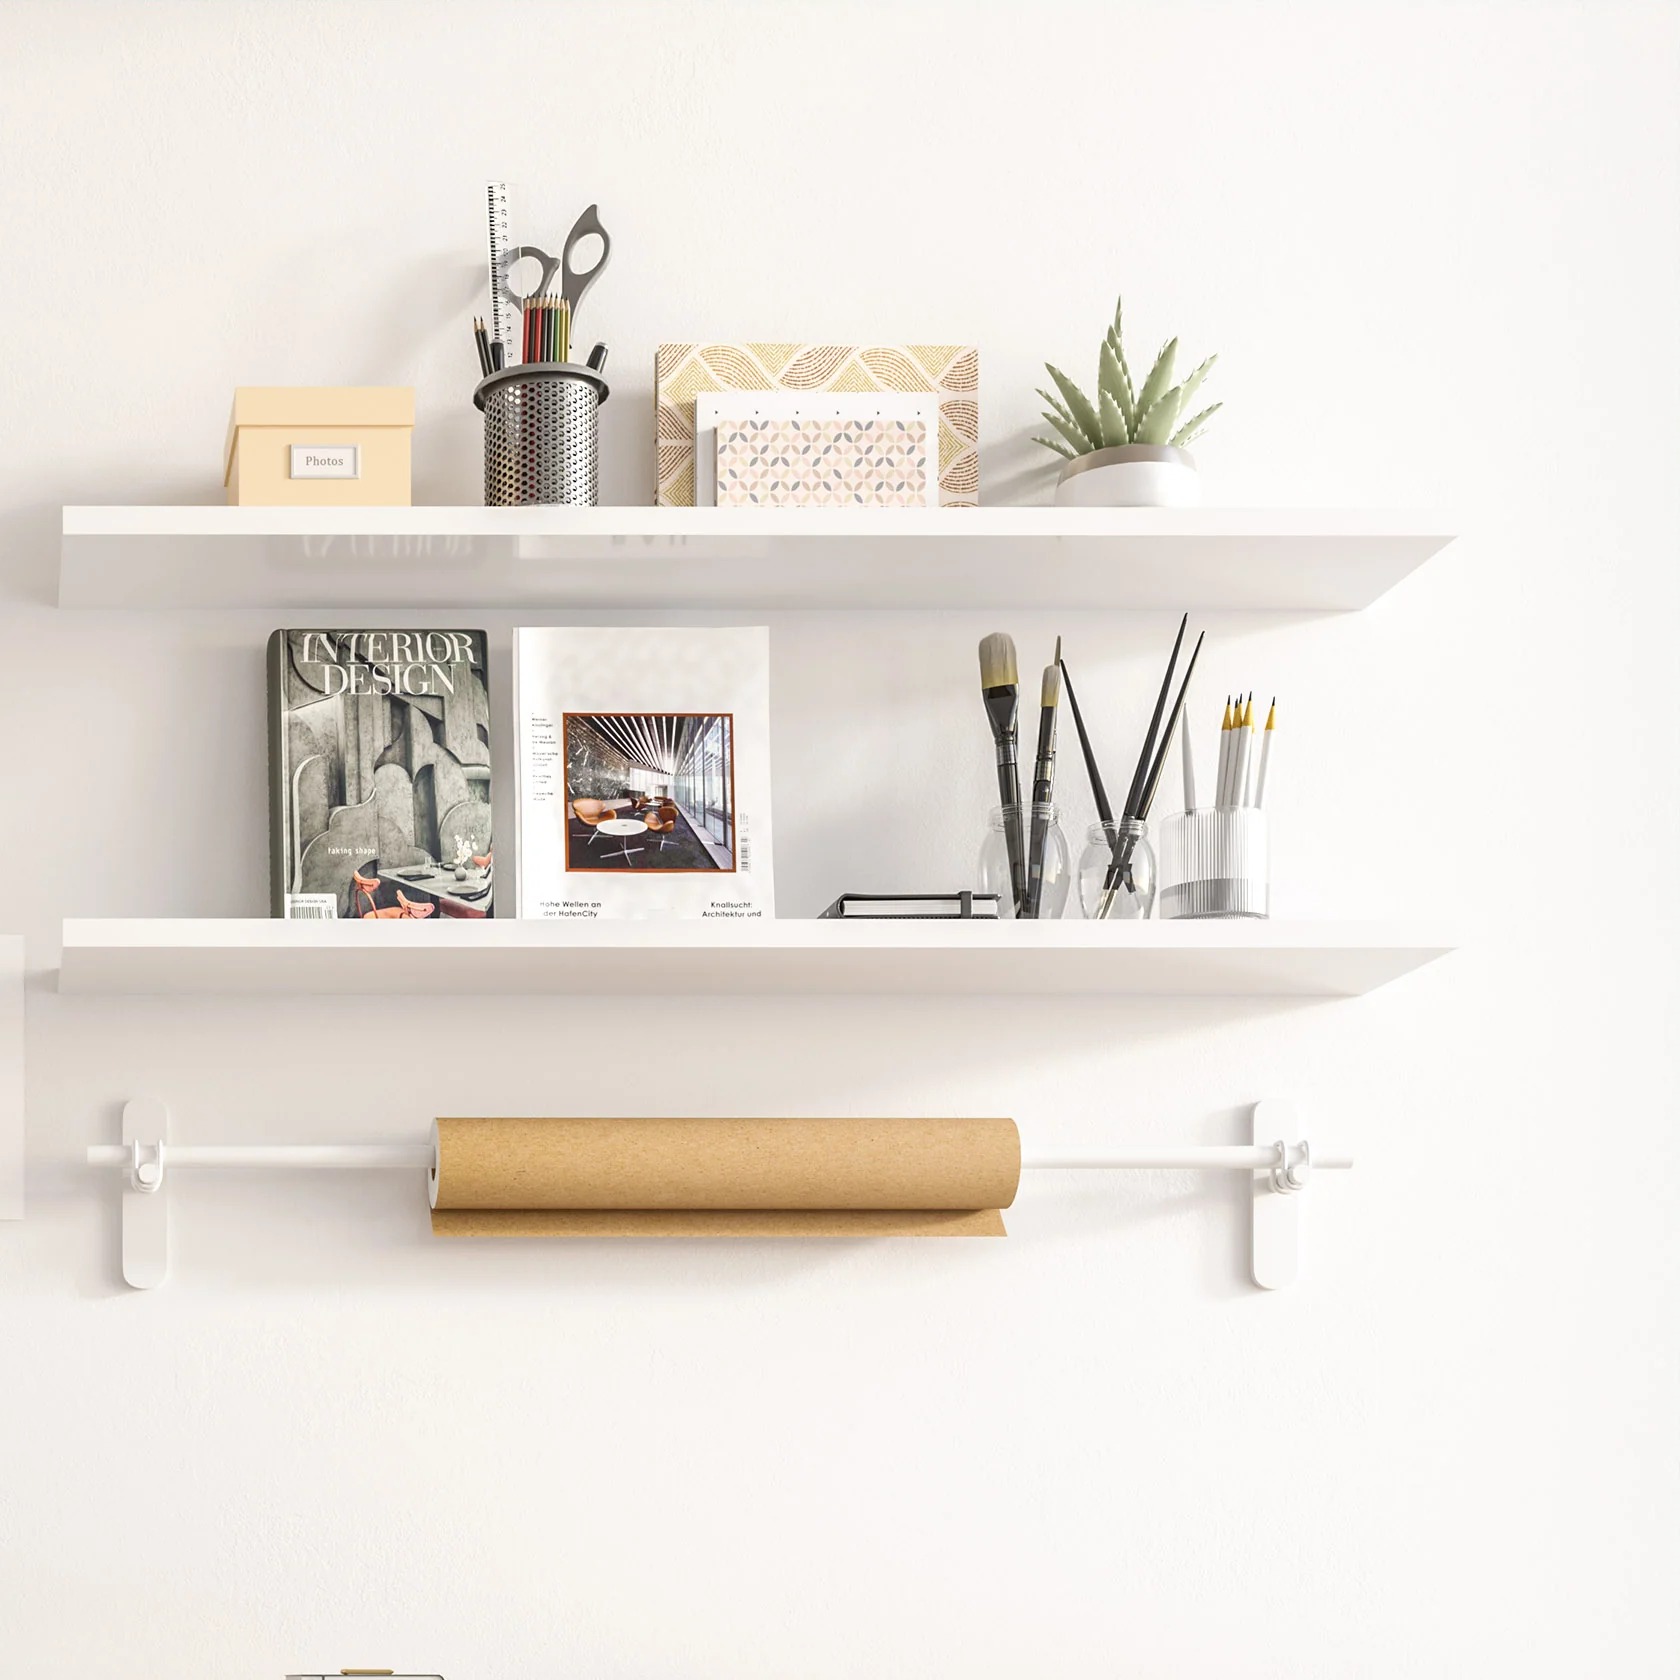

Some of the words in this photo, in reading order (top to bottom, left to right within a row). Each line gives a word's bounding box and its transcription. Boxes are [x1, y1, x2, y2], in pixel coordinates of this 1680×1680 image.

[305, 455, 344, 466] Photos
[300, 632, 478, 664] INTERIOR
[321, 663, 456, 695] DESIGN
[327, 846, 352, 856] taking
[355, 846, 376, 856] shape
[558, 910, 598, 919] HafenCity
[702, 910, 745, 918] Architektur
[747, 909, 762, 917] und
